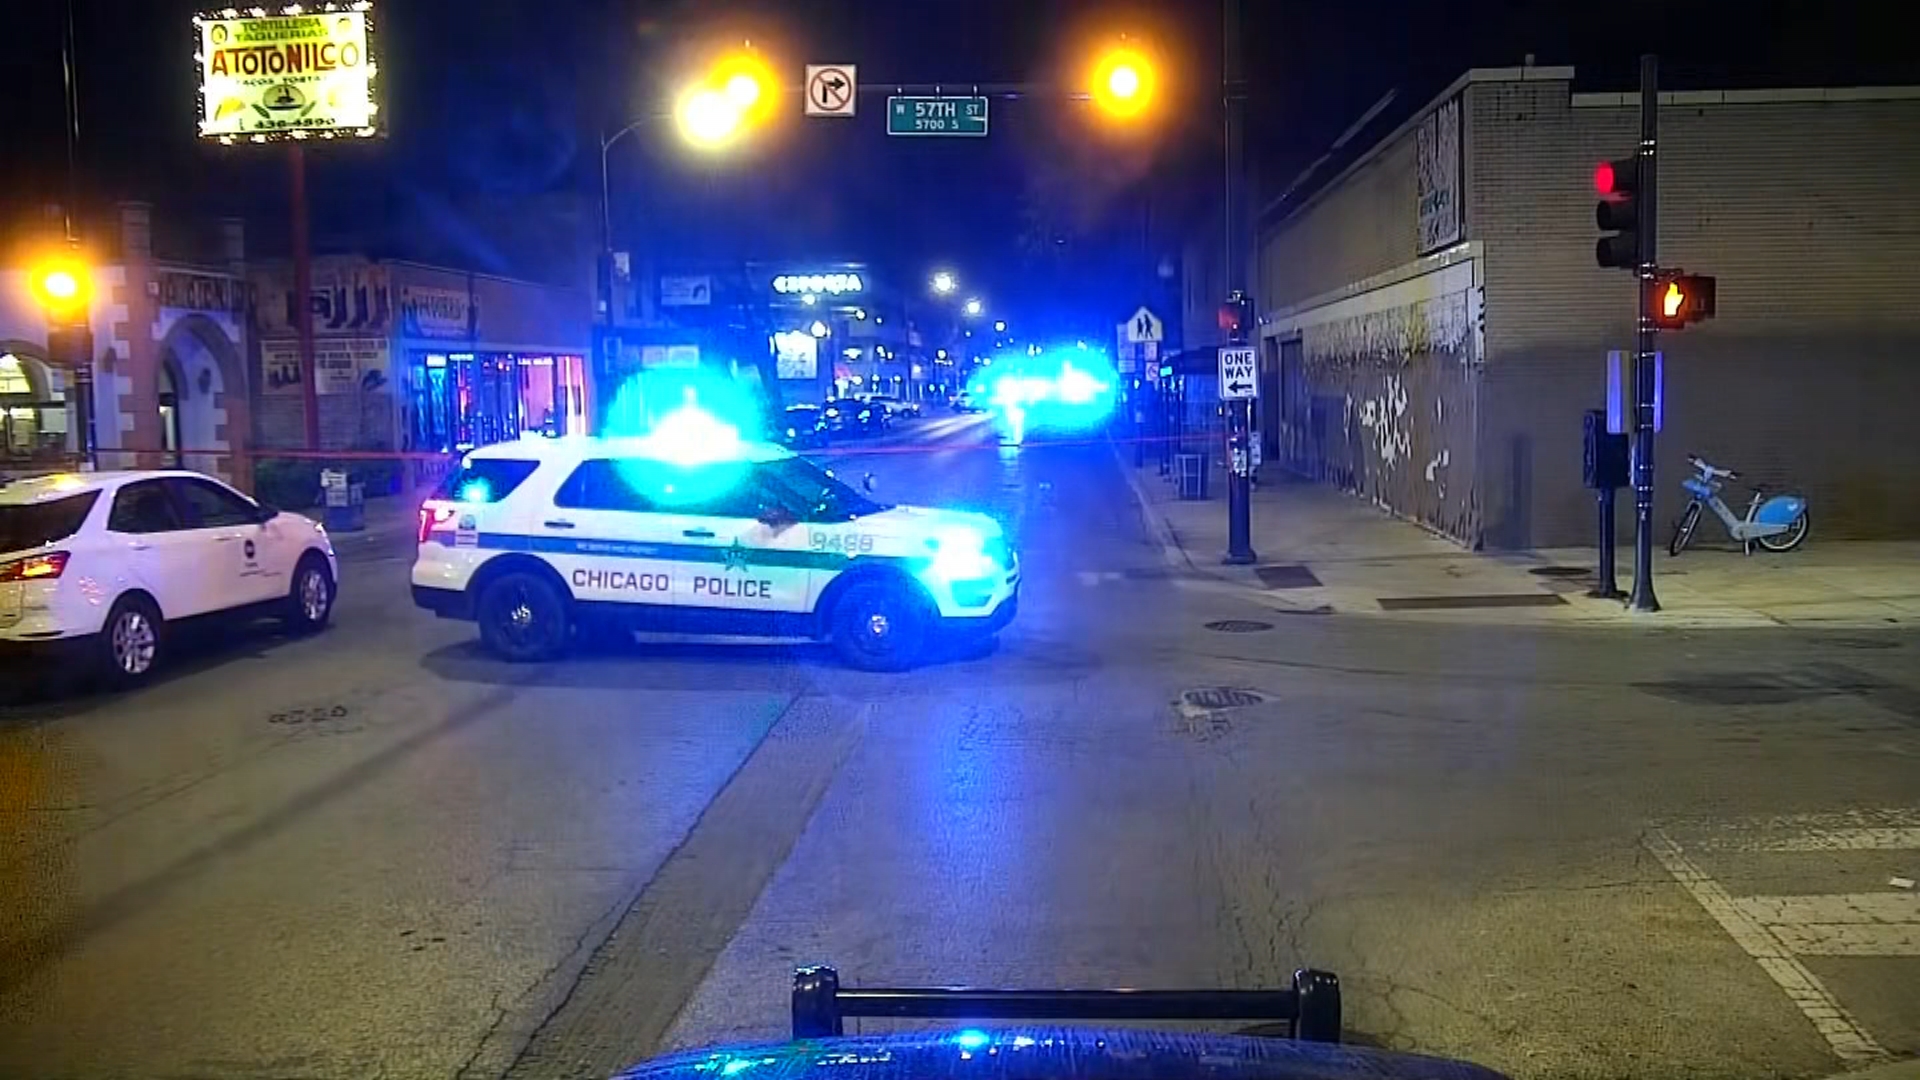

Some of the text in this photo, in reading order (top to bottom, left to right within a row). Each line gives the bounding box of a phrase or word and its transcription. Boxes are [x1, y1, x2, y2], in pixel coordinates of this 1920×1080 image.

[239, 17, 321, 33] TORTILLERIA
[211, 42, 359, 77] ATOTONILCO
[895, 102, 979, 118] W 57TH ST
[915, 120, 960, 130] 5700 S
[1224, 352, 1252, 365] ONE
[1224, 366, 1253, 379] WAY
[572, 569, 772, 599] CHICAGO POLICE
